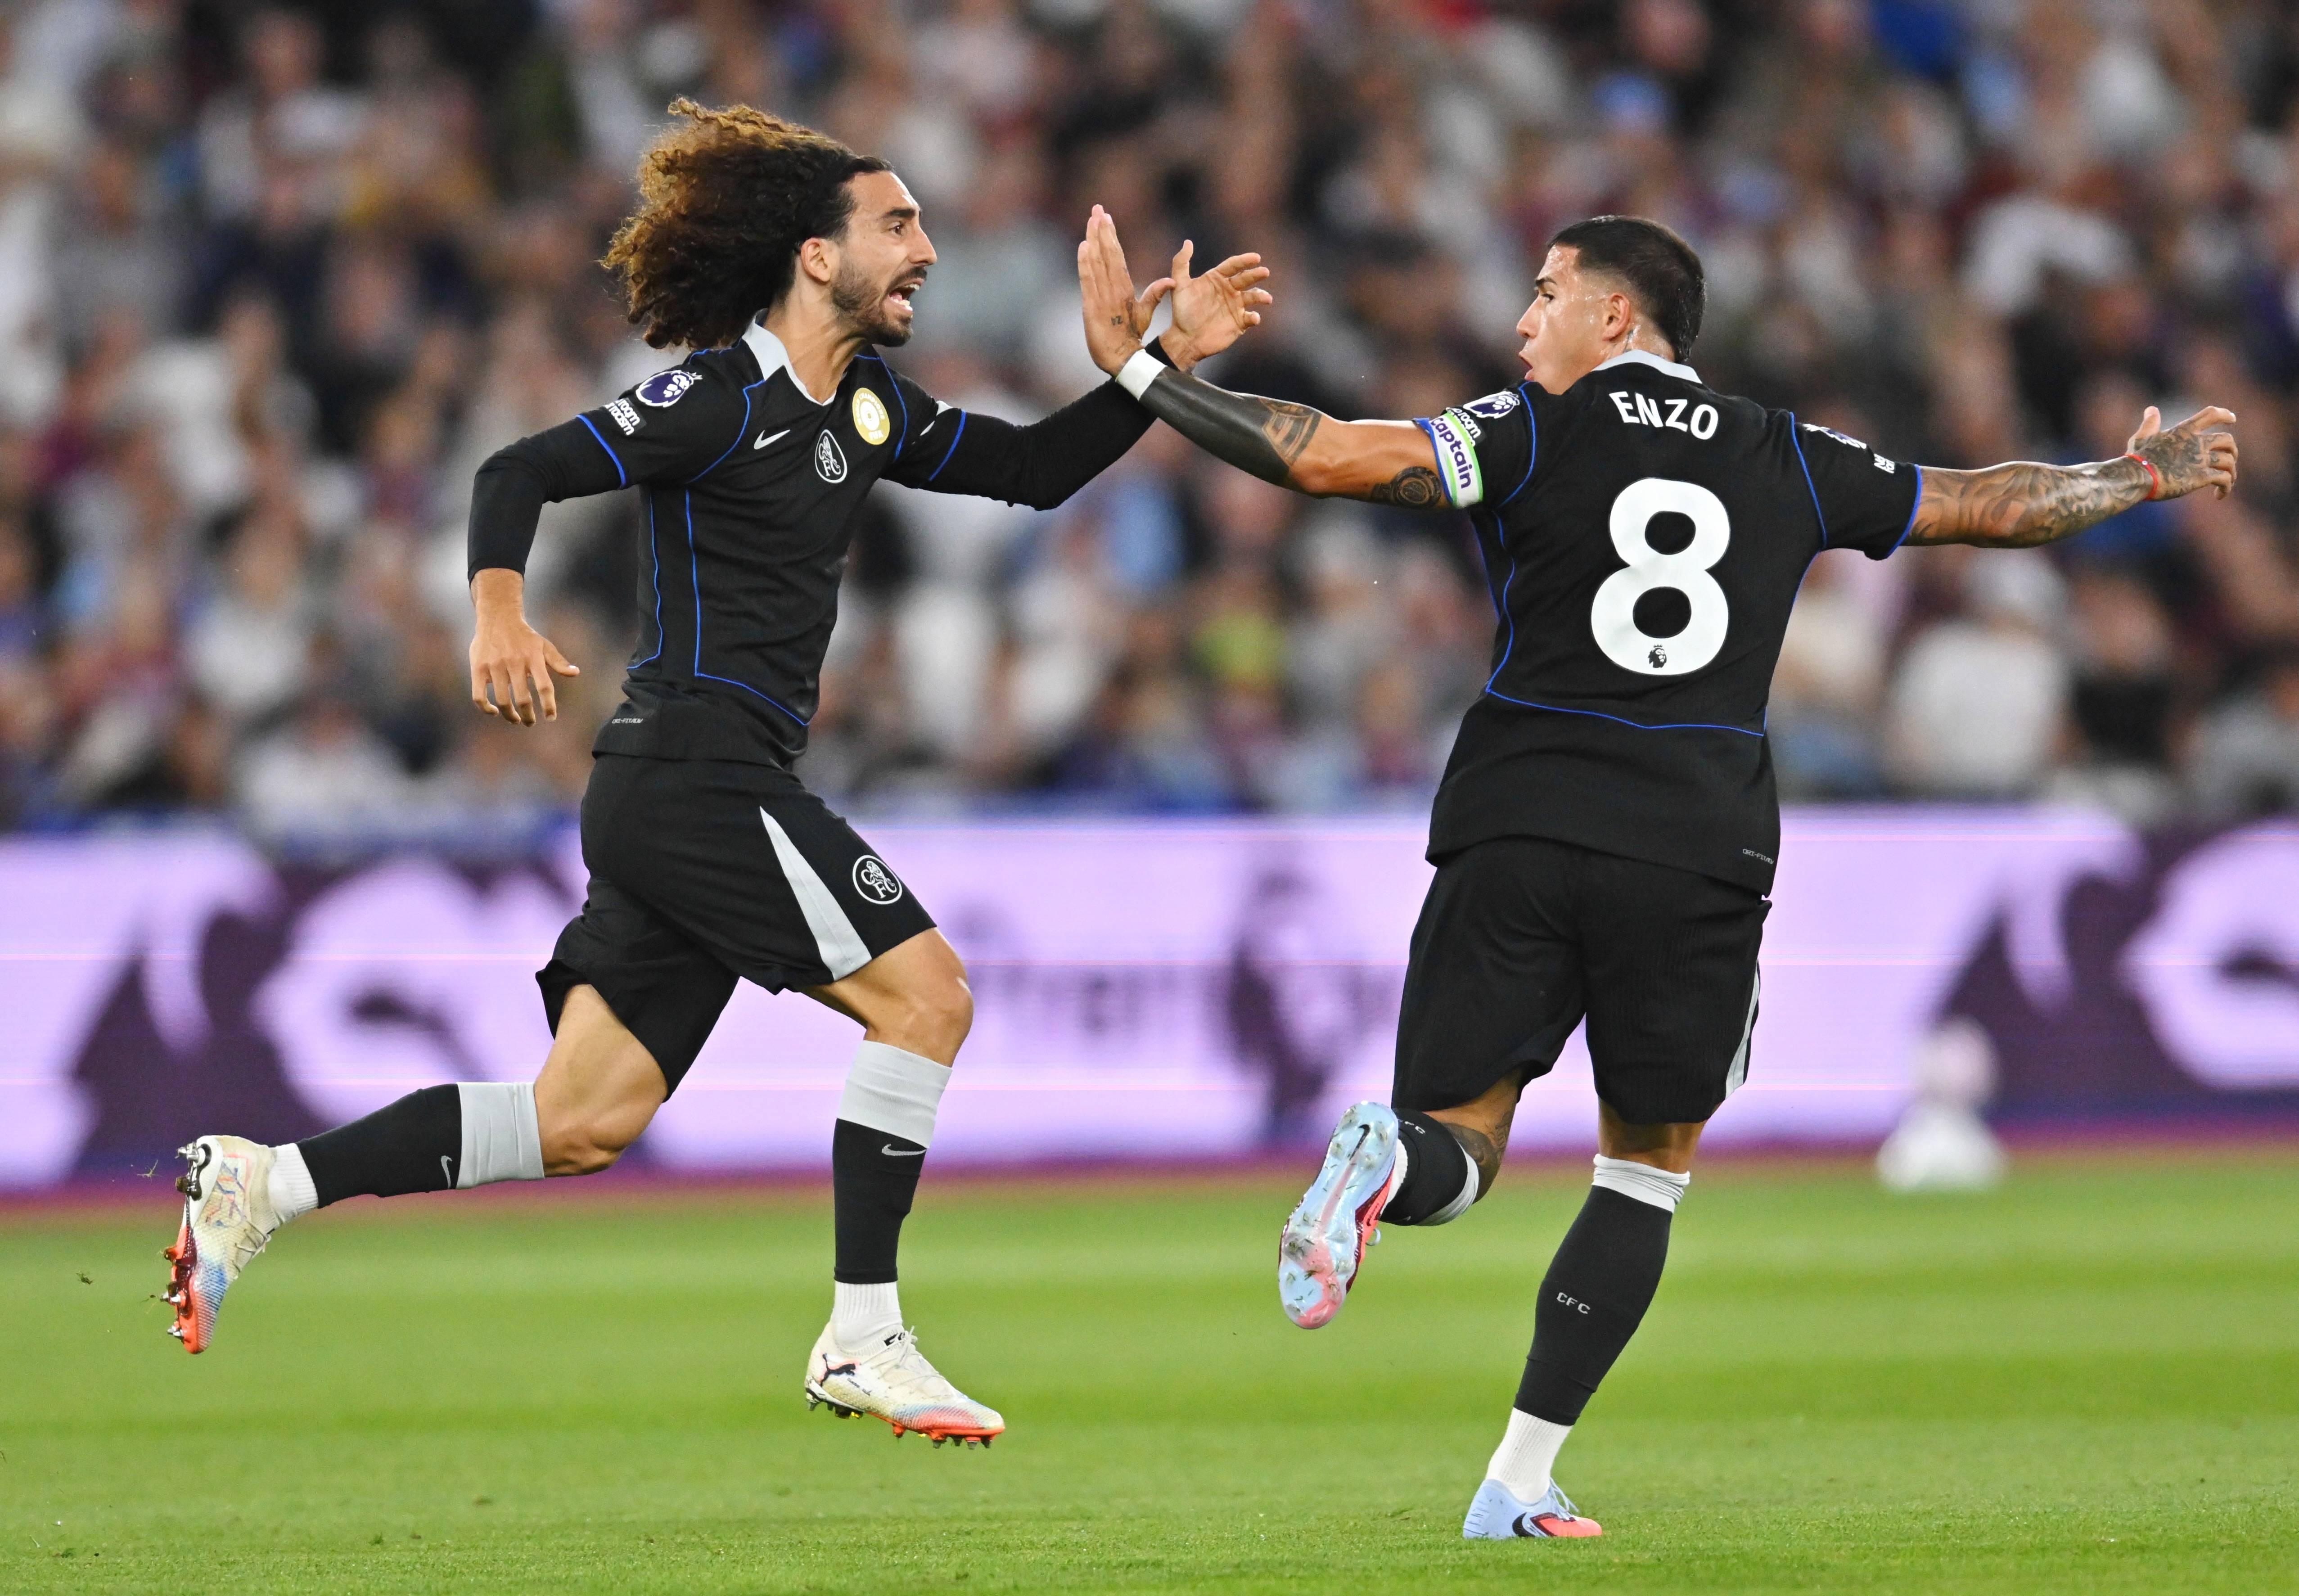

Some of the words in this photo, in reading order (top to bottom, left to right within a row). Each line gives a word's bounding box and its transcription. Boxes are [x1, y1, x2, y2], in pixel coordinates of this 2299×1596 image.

[1457, 412, 1481, 439] room
[1609, 391, 1718, 440] ENZO
[1430, 417, 1473, 489] captain
[1591, 477, 1731, 676] 8
[1556, 1292, 1591, 1314] CFC
